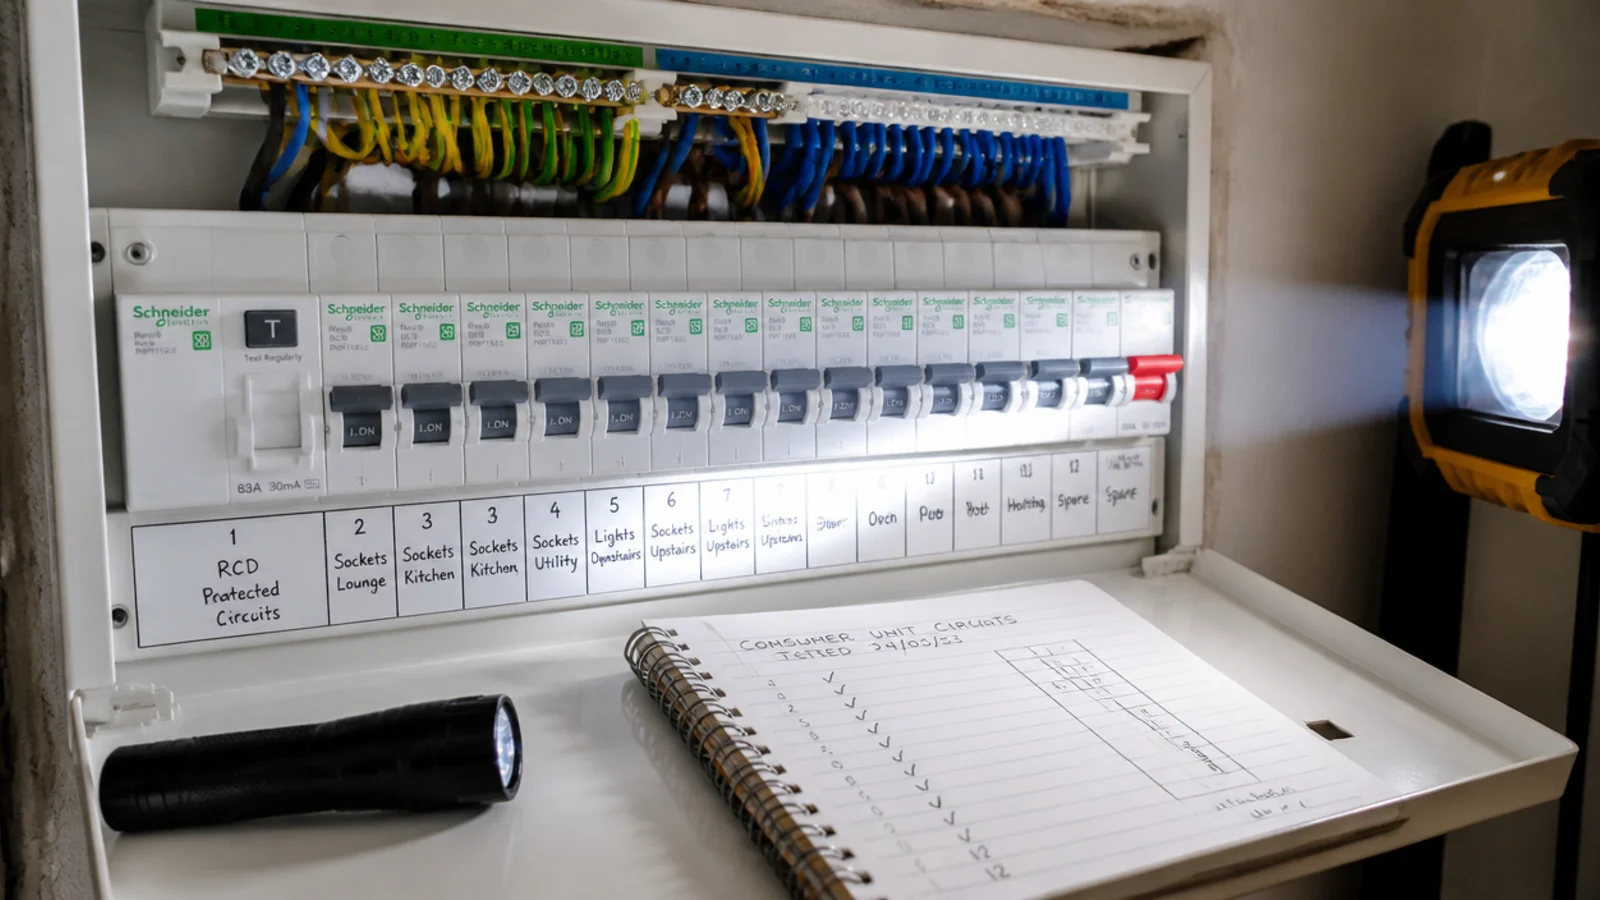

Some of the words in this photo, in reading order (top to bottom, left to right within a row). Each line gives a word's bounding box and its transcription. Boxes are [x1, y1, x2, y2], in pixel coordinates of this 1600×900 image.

[133, 306, 209, 327] Schneider
[328, 304, 385, 320] Schneider
[399, 303, 453, 320] Schneider
[467, 302, 520, 318] Schneider
[264, 319, 281, 339] T
[269, 480, 301, 492] 30mA
[722, 487, 732, 502] 7
[610, 496, 620, 513] 5
[667, 491, 677, 508] 6
[487, 506, 498, 524] 3
[550, 501, 561, 519] 4
[354, 518, 366, 535] 2
[421, 512, 433, 530] 3
[708, 519, 746, 536] Lights
[229, 528, 236, 545] 1
[594, 528, 635, 548] Lights
[650, 523, 695, 539] Sockets
[469, 538, 519, 556] Sockets
[532, 532, 580, 549] Sockets
[334, 552, 388, 569] Sockets
[402, 544, 454, 562] Sockets
[650, 543, 697, 562] Upstairs
[217, 558, 259, 578] RCD
[534, 555, 579, 574] Utility
[404, 567, 455, 585] Kitchen
[336, 576, 387, 595] Lounge
[216, 605, 281, 627] Circuits
[968, 844, 992, 861] 12
[984, 862, 1012, 882] 12
